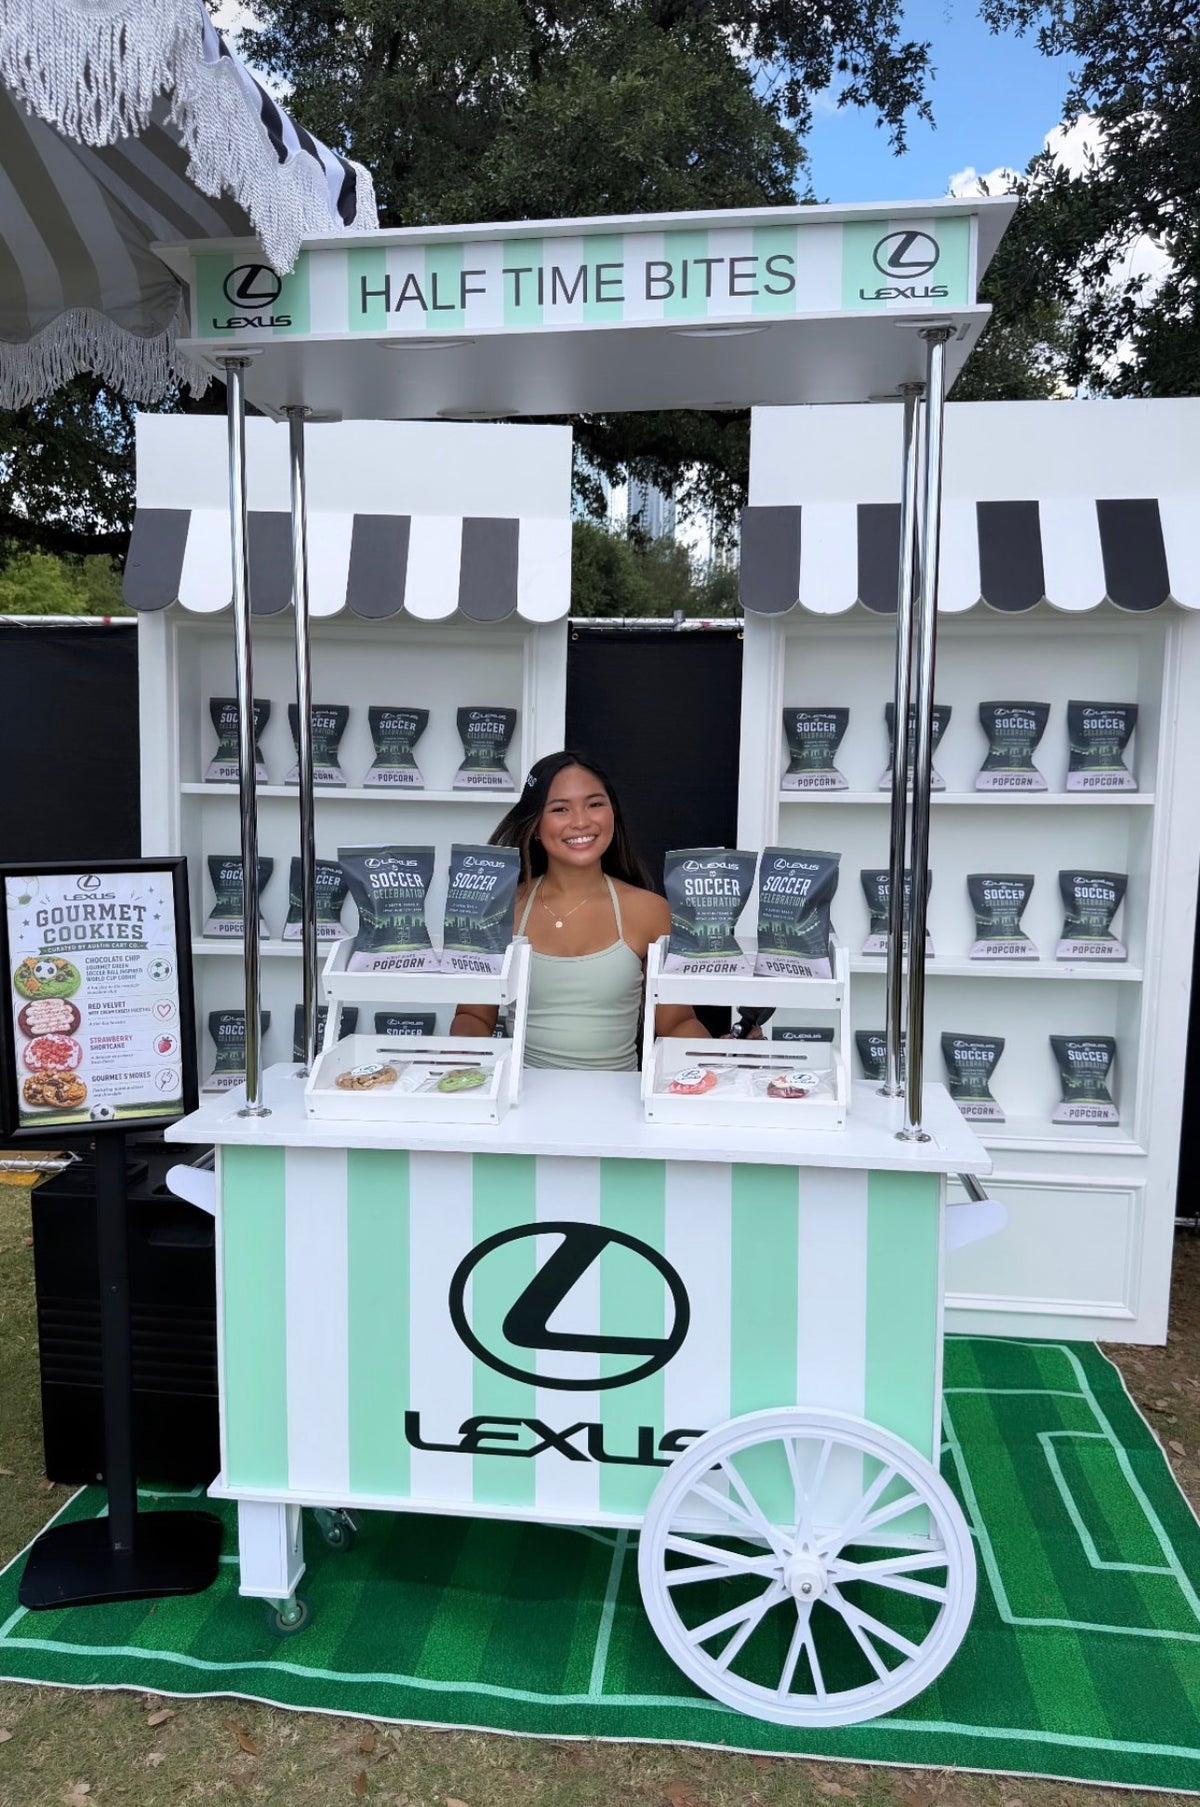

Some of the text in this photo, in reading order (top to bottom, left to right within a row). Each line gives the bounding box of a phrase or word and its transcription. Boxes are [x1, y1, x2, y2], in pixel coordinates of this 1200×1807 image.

[360, 254, 797, 314] HALF TIME BITES
[858, 285, 950, 301] LEXUS
[212, 314, 292, 330] LEXUS
[311, 717, 336, 729] CCER
[379, 720, 416, 732] SOCCER
[467, 722, 505, 735] SOCCER
[796, 721, 837, 733] SOCCER
[994, 718, 1036, 730] SOCCER
[1083, 718, 1125, 730] SOCCER
[312, 772, 334, 781] CORN
[377, 773, 414, 783] POPCORN
[467, 776, 503, 785] POPCORN
[992, 777, 1033, 786] POPCORN
[1083, 777, 1125, 786] POPCORN
[797, 778, 836, 787] POPCORN
[381, 858, 418, 867] LEXUS
[474, 860, 506, 869] LEXUS
[698, 862, 740, 871] LEXUS
[786, 862, 820, 871] LEXUS
[316, 875, 341, 886] CCER
[370, 872, 425, 888] SOCCER
[452, 872, 498, 891] SOCCER
[685, 878, 741, 896] SOCCER
[762, 875, 812, 897] SOCCER
[63, 892, 116, 901] LEXUS
[983, 888, 1026, 900] SOCCER
[1074, 886, 1116, 902] SOCCER
[36, 903, 147, 928] GOURMET
[43, 923, 143, 944] COOKIES
[316, 928, 337, 937] CORN
[48, 944, 77, 953] CURATED
[77, 943, 86, 951] BY
[986, 945, 1027, 954] POPCORN
[1071, 945, 1113, 954] POPCORN
[85, 954, 141, 964] CHOCOLATE CHIP
[373, 957, 425, 971] POPCORN
[451, 957, 492, 973] POPCORN
[683, 963, 738, 974] POPCORN
[766, 960, 813, 977] POPCORN
[87, 1001, 126, 1010] RED VELVET
[219, 1024, 245, 1035] SOCC
[89, 1035, 133, 1044] STRAWBERRY
[90, 1042, 126, 1051] SHORTCAKE
[954, 1050, 995, 1062] SOCCER
[1068, 1050, 1109, 1062] SOCCER
[91, 1071, 152, 1082] GOURMET S'MORES
[959, 1107, 994, 1115] OPCORN
[1069, 1108, 1109, 1118] POPCORN
